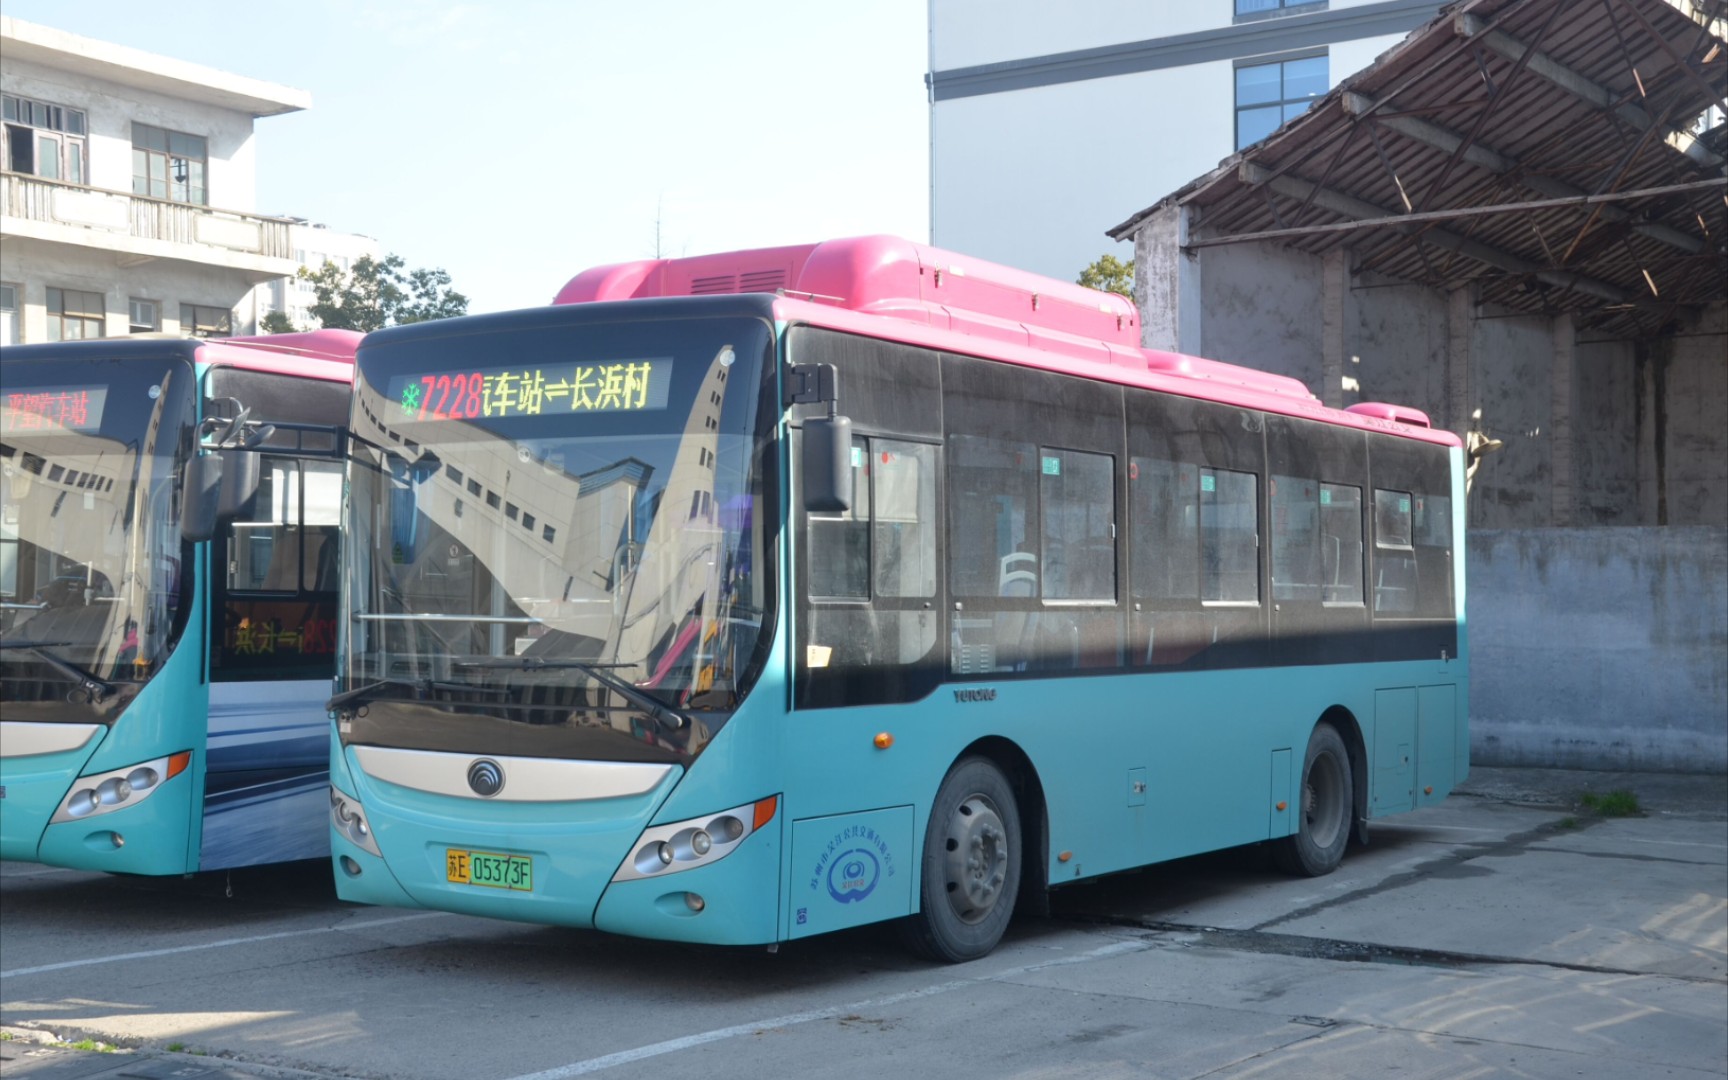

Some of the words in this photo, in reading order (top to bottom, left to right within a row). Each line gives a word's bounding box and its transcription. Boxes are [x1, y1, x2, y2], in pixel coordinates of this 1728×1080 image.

[418, 372, 483, 421] 7228
[953, 688, 997, 703] YUTONG
[473, 857, 529, 885] 05373F
